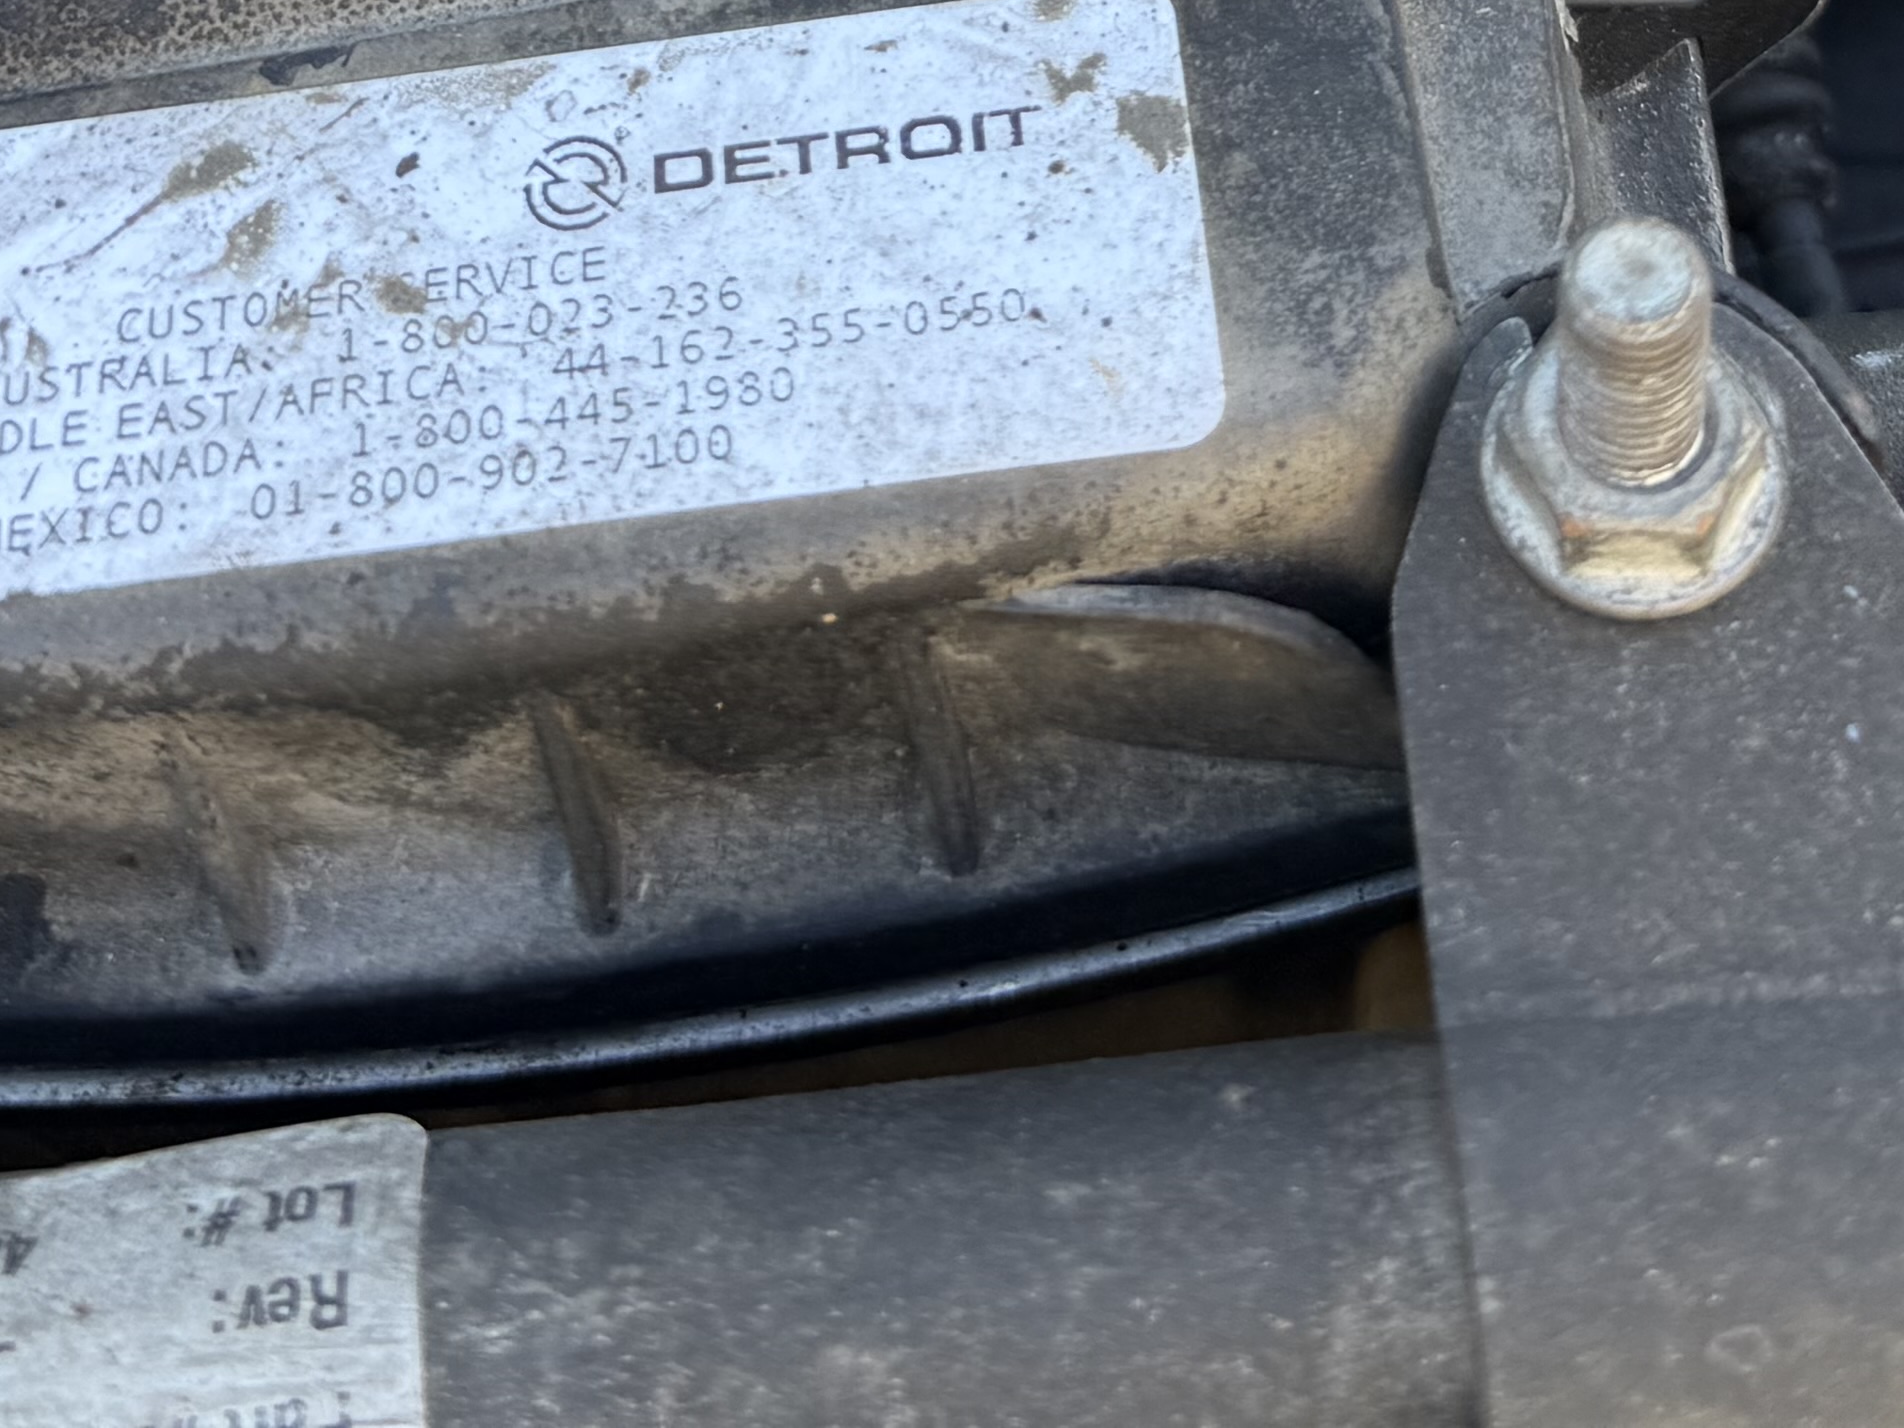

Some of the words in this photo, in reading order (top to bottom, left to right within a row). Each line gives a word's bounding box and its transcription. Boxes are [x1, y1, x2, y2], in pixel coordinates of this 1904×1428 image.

[650, 98, 1046, 198] DETROIT
[114, 275, 366, 348] CUSTOMER
[338, 270, 745, 365] 1-800-023-236
[113, 351, 489, 444] EAST/AFRICA:
[551, 283, 1028, 387] 44-162-355-0550
[72, 428, 287, 498] CANADA:
[350, 362, 799, 463] 1-800-445-1980
[247, 418, 737, 528] 01-800-902-7100
[181, 1195, 242, 1246] #:
[262, 1180, 357, 1234] Lot
[209, 1268, 350, 1334] Rev:
